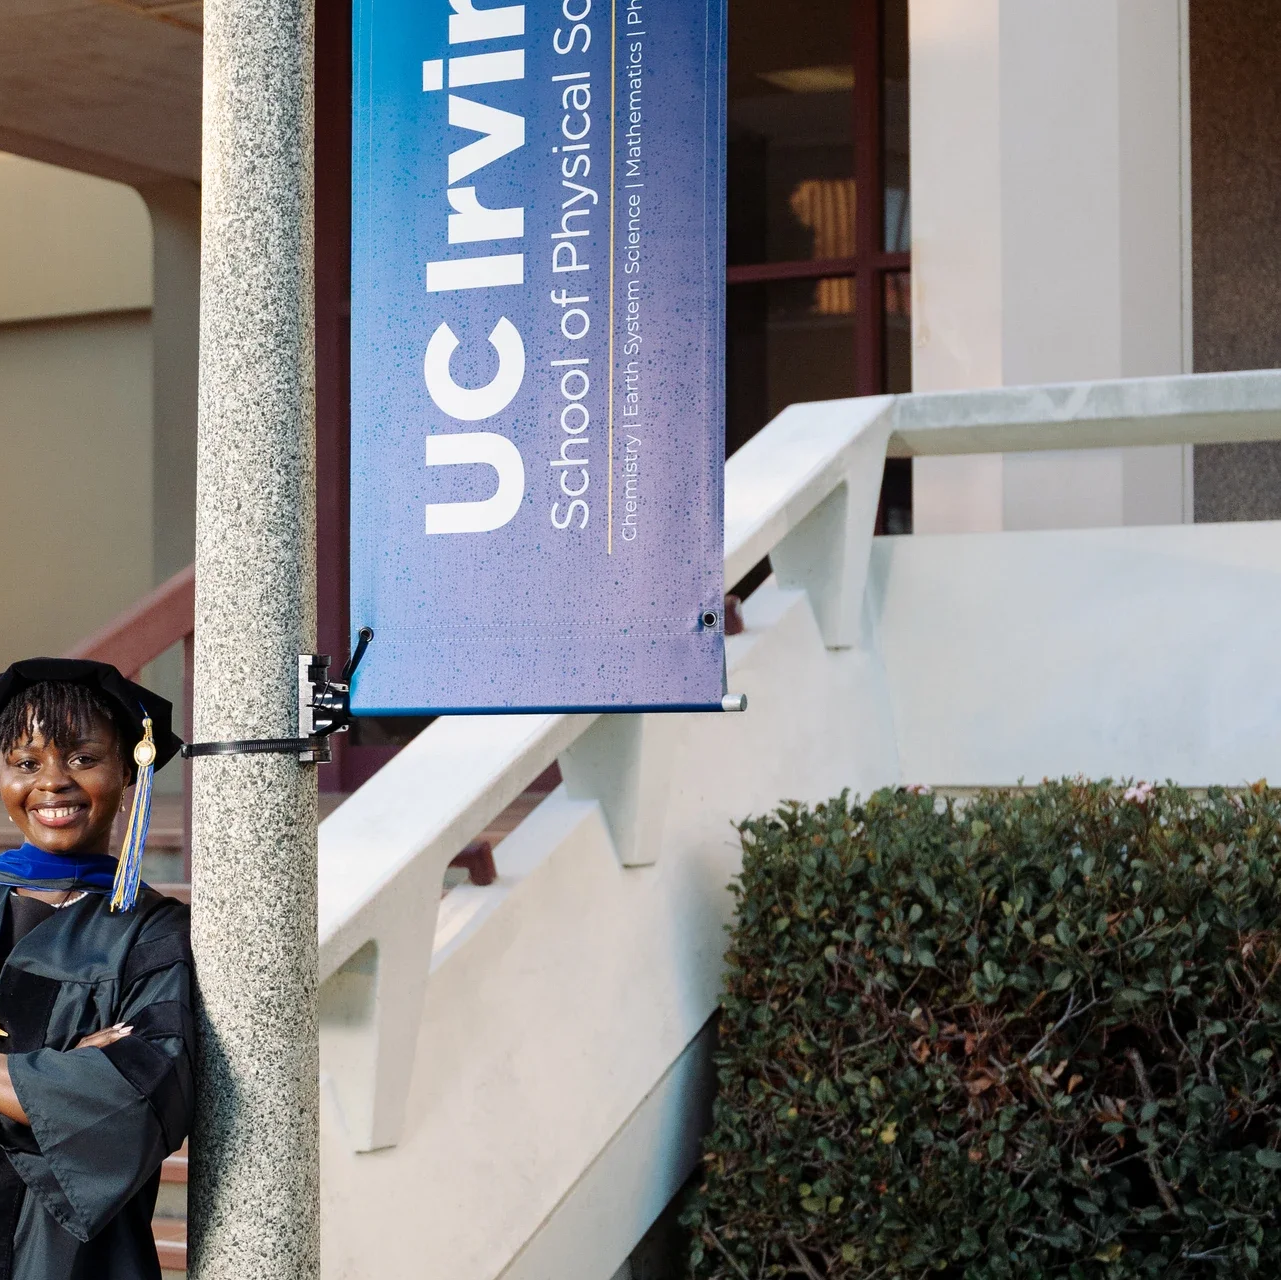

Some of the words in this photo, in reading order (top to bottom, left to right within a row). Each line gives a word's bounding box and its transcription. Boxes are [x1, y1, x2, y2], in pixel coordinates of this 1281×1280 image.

[625, 40, 643, 177] Mathematics
[550, 70, 599, 273] Physical
[623, 194, 641, 274] Science
[550, 288, 591, 340] of
[623, 280, 643, 355] System
[423, 315, 526, 535] UC
[549, 357, 591, 530] School
[622, 361, 639, 418] Earth
[621, 433, 642, 542] Chemistry
